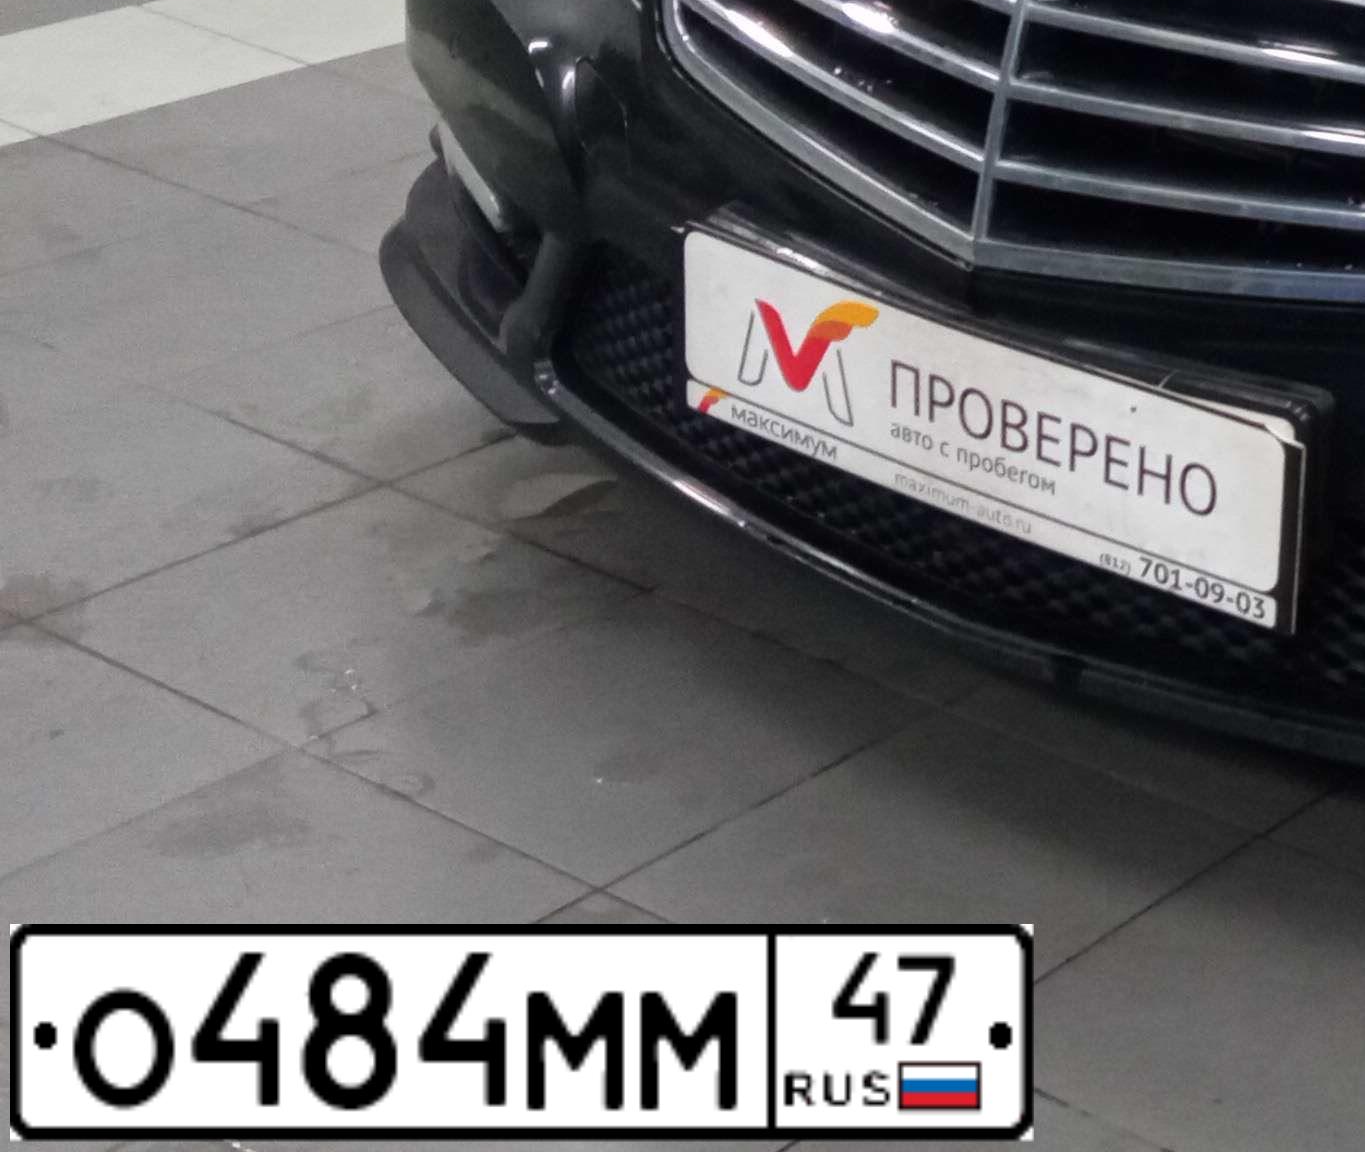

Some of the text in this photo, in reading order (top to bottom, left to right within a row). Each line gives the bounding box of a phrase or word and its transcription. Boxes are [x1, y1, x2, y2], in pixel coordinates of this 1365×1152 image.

[731, 404, 837, 460] максимум
[890, 360, 1217, 516] ПРОВЕРЕНО
[890, 421, 1056, 495] авто с пробегом
[1138, 556, 1266, 619] 701-09-03
